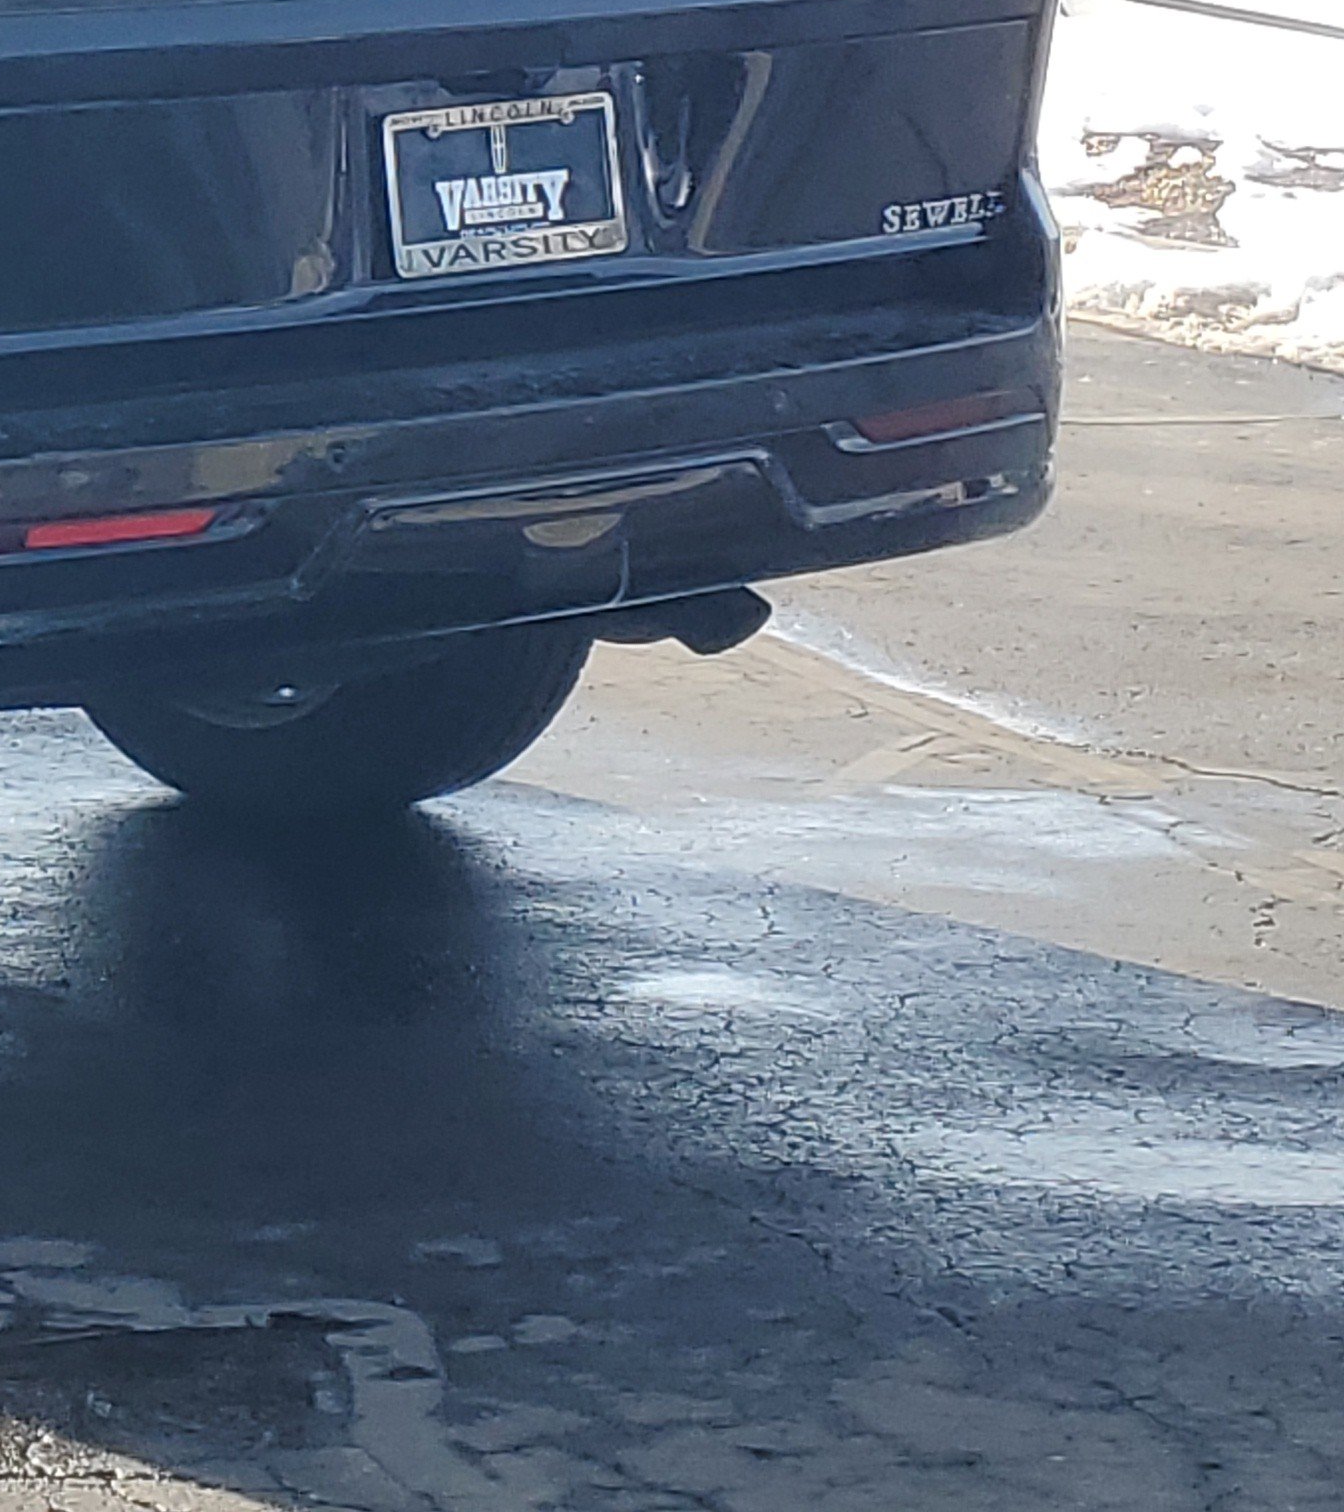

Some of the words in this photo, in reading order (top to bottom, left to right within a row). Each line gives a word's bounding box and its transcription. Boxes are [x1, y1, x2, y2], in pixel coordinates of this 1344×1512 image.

[444, 99, 553, 127] LINCOLN
[435, 169, 569, 230] VARSITY
[422, 226, 600, 269] VARSITY
